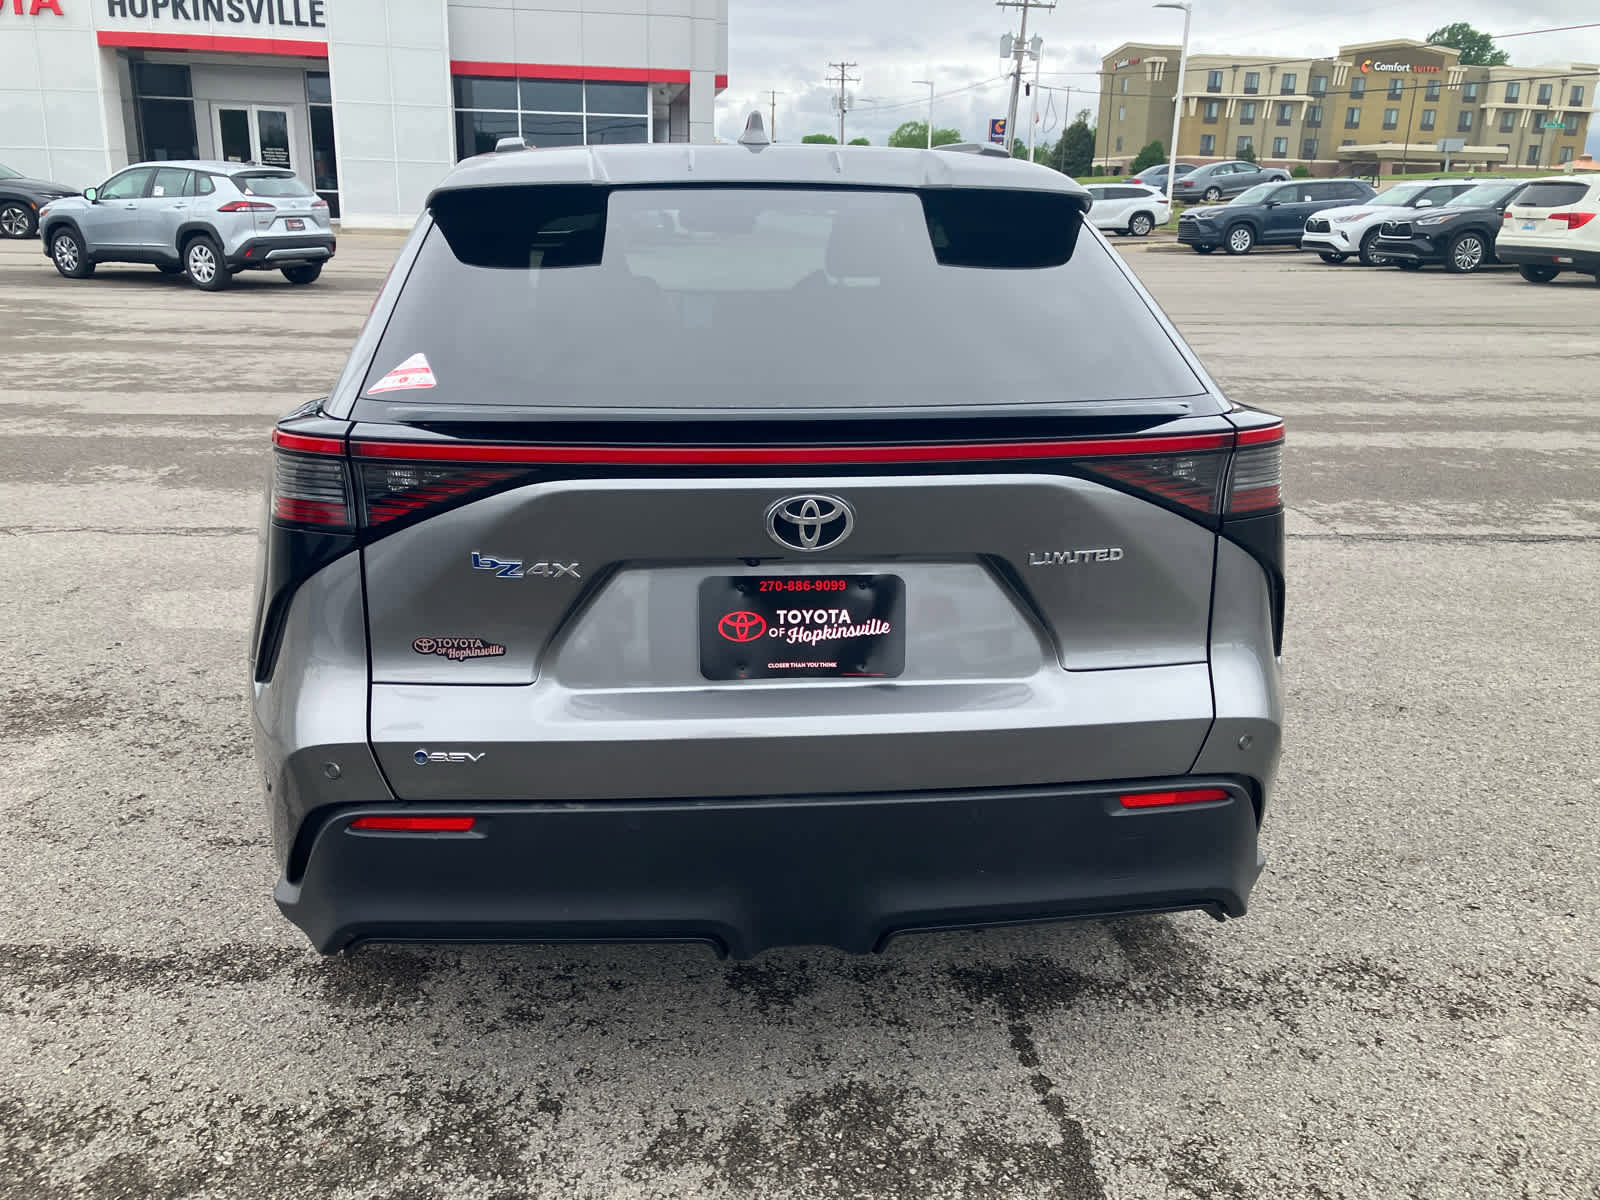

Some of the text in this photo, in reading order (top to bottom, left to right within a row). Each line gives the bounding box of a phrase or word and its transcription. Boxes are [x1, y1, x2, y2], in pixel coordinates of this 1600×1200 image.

[1374, 61, 1410, 72] Comfort
[1028, 548, 1124, 566] LIMITED
[759, 580, 847, 593] 270-886-9099
[776, 609, 851, 625] TOYOTA
[768, 618, 891, 647] OF Hopkinsville
[436, 638, 484, 648] TOYOTA
[436, 644, 505, 660] OF Hopkinsville
